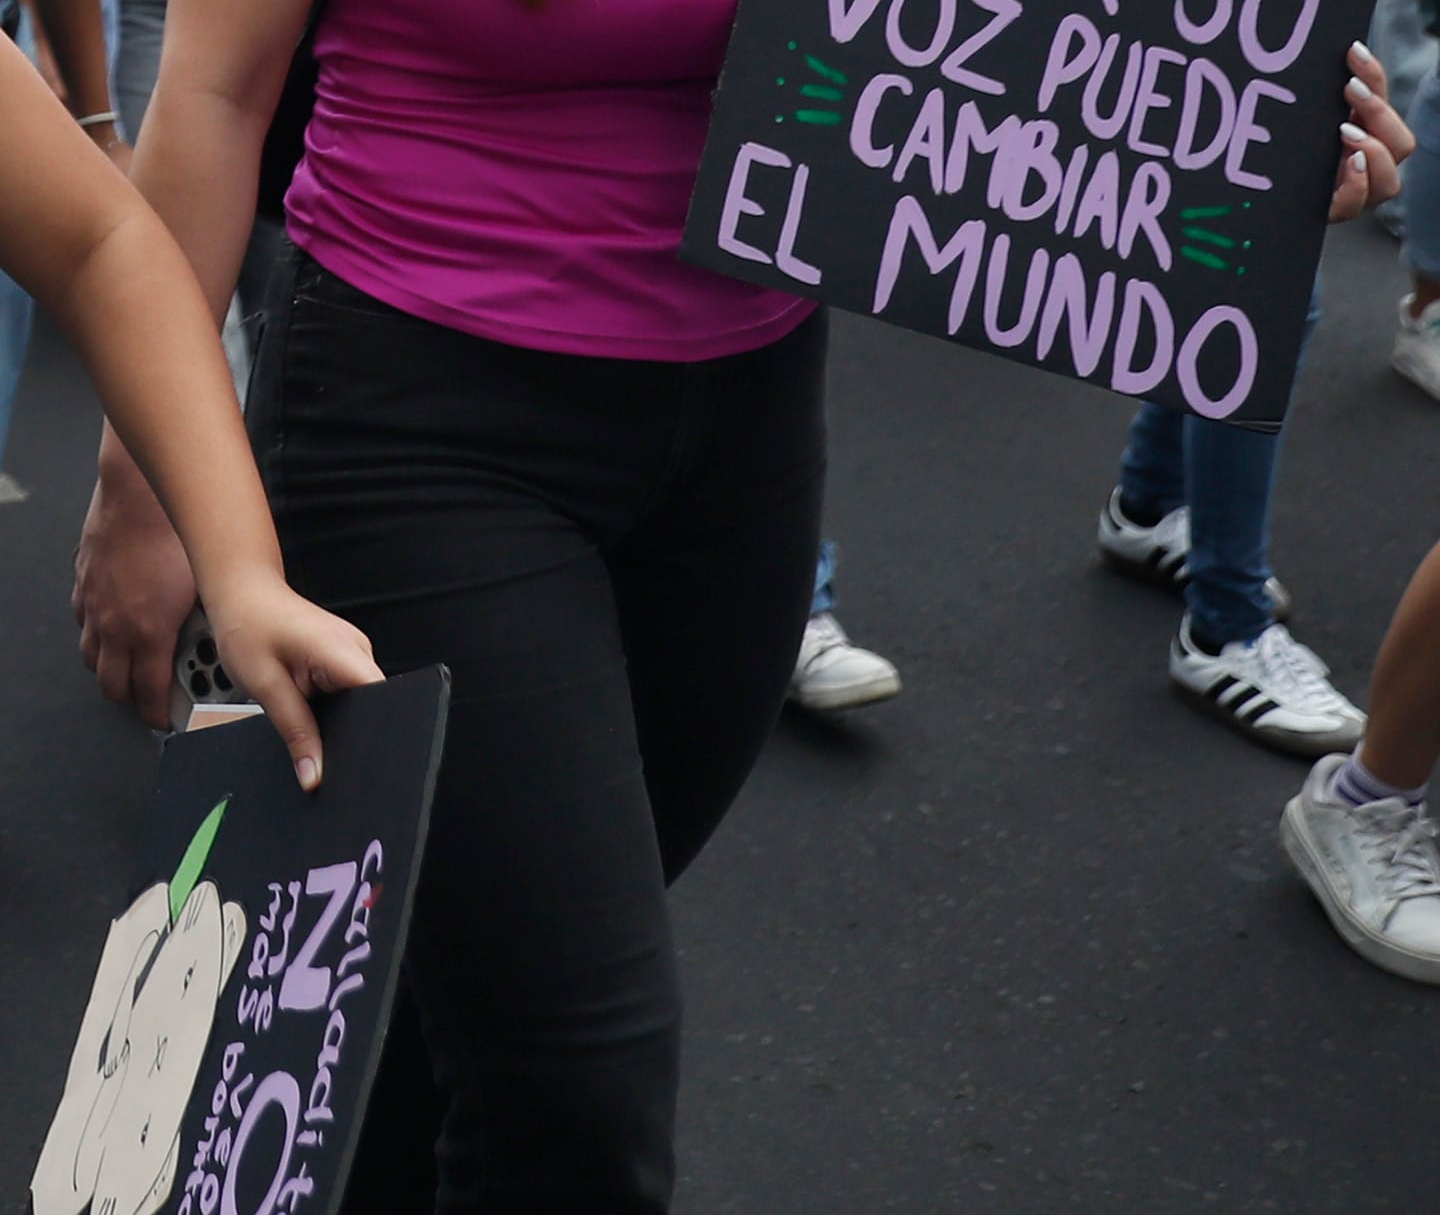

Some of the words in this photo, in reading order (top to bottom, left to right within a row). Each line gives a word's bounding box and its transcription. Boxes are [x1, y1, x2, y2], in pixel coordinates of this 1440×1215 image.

[848, 72, 1173, 272] CAMBIAR
[1037, 12, 1297, 190] PUEDE
[716, 140, 823, 286] EL
[871, 195, 1260, 420] MUNDO
[273, 837, 384, 1215] Calladit
